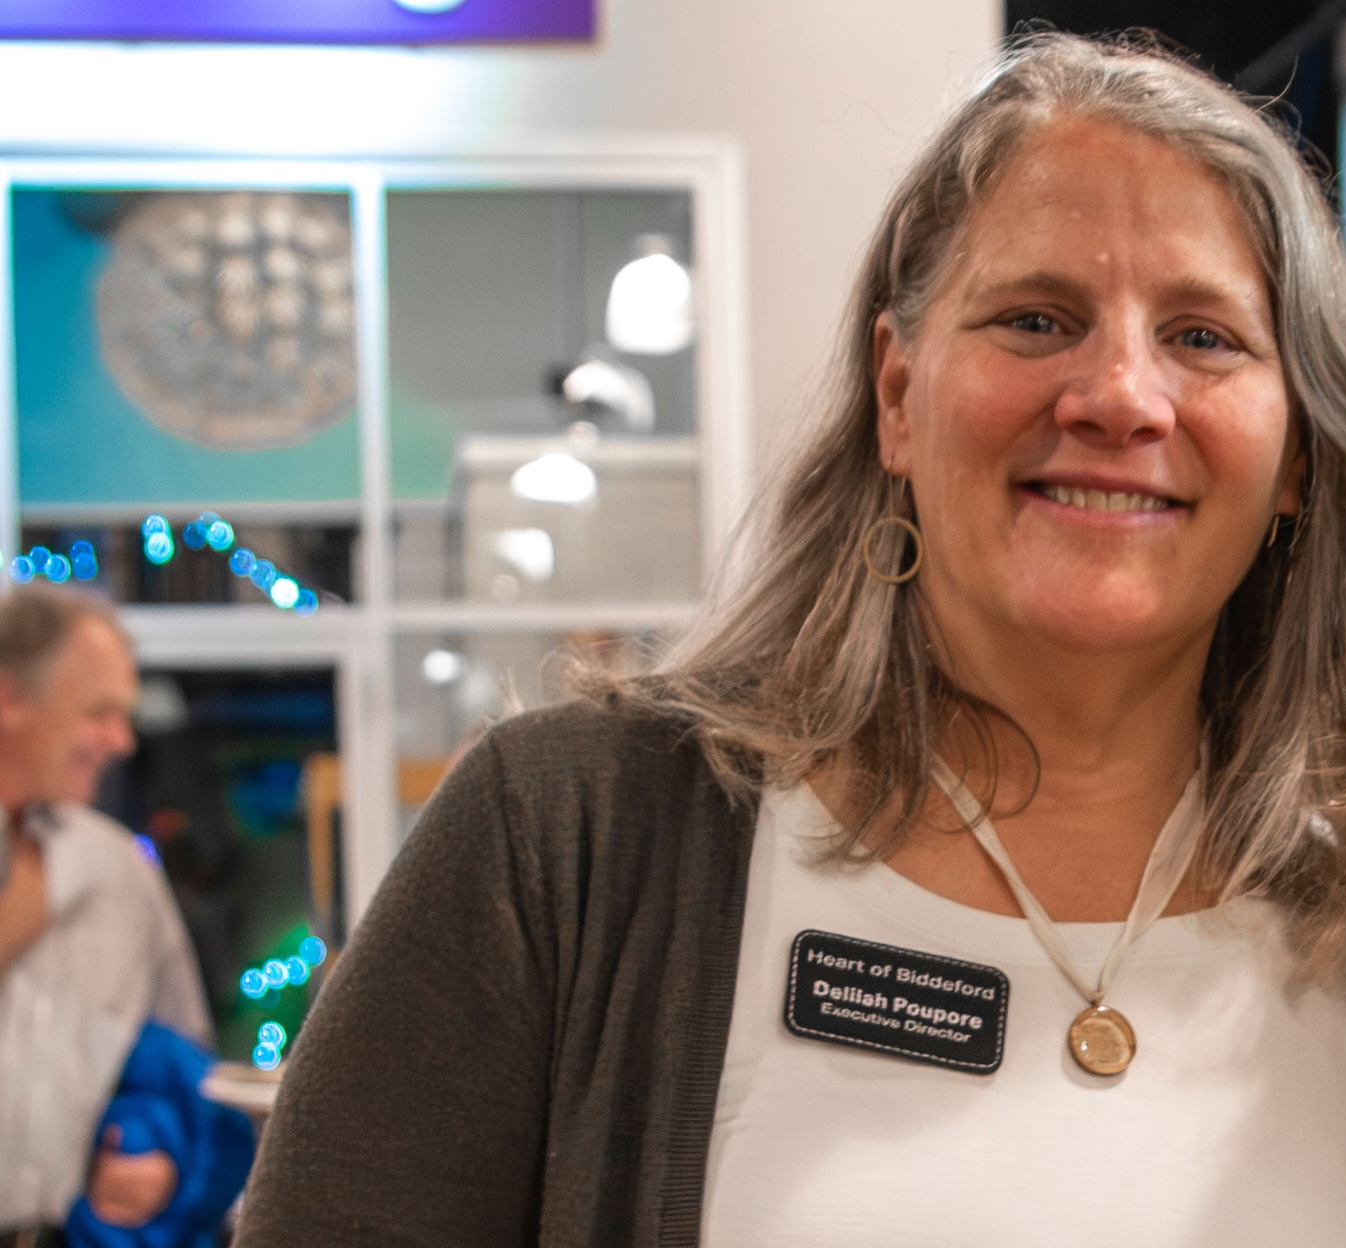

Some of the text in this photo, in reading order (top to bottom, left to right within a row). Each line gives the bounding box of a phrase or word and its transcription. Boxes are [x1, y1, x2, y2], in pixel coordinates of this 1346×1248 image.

[807, 948, 996, 1001] Heart of Biddeford
[812, 980, 984, 1030] Delilah Poupore
[820, 1002, 972, 1043] Executive Director
